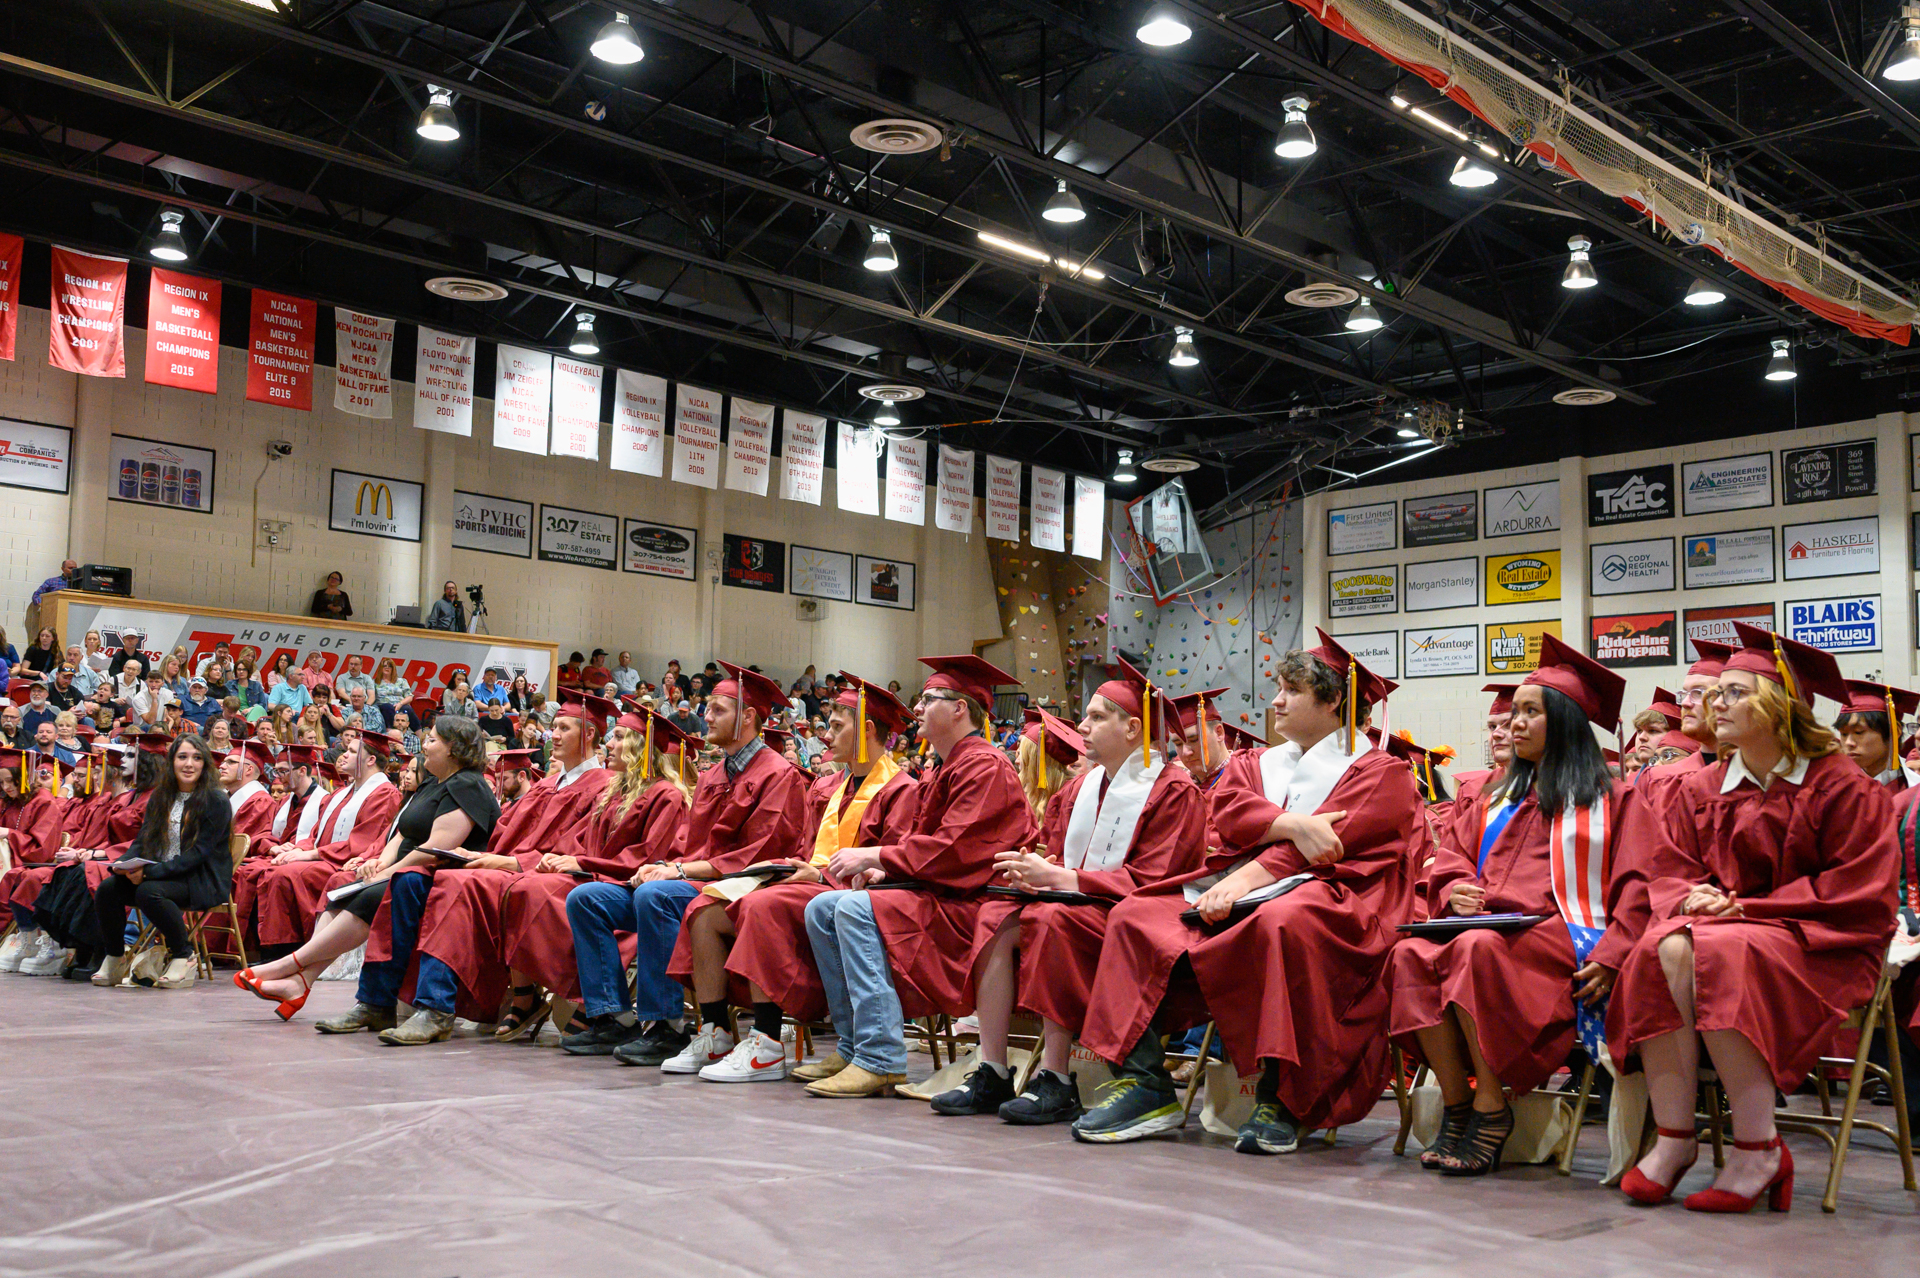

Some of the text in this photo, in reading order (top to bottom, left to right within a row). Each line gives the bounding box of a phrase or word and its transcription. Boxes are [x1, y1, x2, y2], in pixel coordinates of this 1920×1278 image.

[65, 274, 112, 291] REGION IX
[164, 284, 208, 301] REGION IX
[62, 294, 114, 312] WRESTLING
[270, 300, 298, 314] NJCAA
[172, 305, 200, 319] MEN'S
[58, 314, 114, 332] CHAMPIONS
[264, 312, 303, 329] NATIONAL
[352, 313, 378, 327] COACH
[156, 321, 213, 341] BASKETBALL
[270, 329, 296, 342] MEN'S
[336, 321, 392, 341] KEN ROCHLITZ
[72, 336, 98, 349] 2001
[351, 339, 377, 352] NJCAA
[436, 337, 461, 349] COACH
[156, 341, 210, 360] CHAMPIONS
[255, 340, 308, 359] BASKETBALL
[422, 348, 446, 360] FLOYD
[254, 354, 309, 373] TOURNAMENT
[352, 354, 376, 365] MEN'S
[171, 364, 194, 376] 2015
[339, 363, 387, 381] BASKETBALL
[429, 364, 464, 377] NATIONAL
[503, 371, 516, 380] JIM
[557, 362, 600, 377] VOLLEYBALL
[266, 372, 296, 385] ELITE 8
[337, 376, 390, 394] HALL OF FAME
[426, 377, 467, 391] WRESTLING
[269, 387, 291, 399] 2015
[512, 386, 534, 398] NJCAA
[589, 384, 596, 394] IX
[350, 395, 373, 407] 2001
[420, 390, 470, 406] HALL OF FAME
[625, 392, 648, 404] REGION
[688, 397, 709, 409] NJCAA
[436, 407, 454, 417] 2001
[503, 398, 542, 413] WRESTLING
[498, 411, 546, 427] HALL OF FAME
[621, 407, 660, 422] VOLLEYBALL
[683, 410, 713, 423] NATIONAL
[557, 415, 598, 430] CHAMPIONS
[739, 416, 760, 427] REGION
[796, 423, 814, 433] NJCAA
[513, 427, 530, 438] 2009
[621, 423, 659, 438] CHAMPIONS
[679, 422, 717, 438] VOLLEYBALL
[744, 428, 763, 440] NORTH
[677, 435, 718, 451] TOURNAMENT
[792, 434, 818, 445] NATIONAL
[19, 447, 56, 457] COMPANIES
[632, 442, 648, 452] 2009
[734, 439, 768, 454] VOLLEYBALL
[788, 444, 821, 458] VOLLEYBALL
[898, 444, 916, 454] NJCAA
[689, 451, 704, 461] 11TH
[734, 451, 767, 466] CHAMPIONS
[1848, 450, 1862, 458] 369
[786, 456, 822, 470] TOURNAMENT
[895, 456, 920, 467] NATIONAL
[944, 458, 962, 466] REGION
[1794, 461, 1831, 473] LAVENDER
[688, 464, 704, 475] 2009
[743, 466, 758, 475] 2013
[802, 471, 819, 481] PLACE
[891, 467, 922, 480] VOLLEYBALL
[996, 467, 1012, 475] NJCAA
[1712, 466, 1767, 478] ENGINEERING
[993, 478, 1015, 487] NATIONAL
[1717, 474, 1767, 485] ASSOCIATES
[1802, 472, 1820, 483] ROSE
[797, 482, 811, 491] 2013
[890, 479, 924, 491] TOURNAMENT
[942, 483, 970, 496] VOLLEYBALL
[1845, 483, 1868, 492] Powell
[904, 493, 920, 504] PLACE
[990, 489, 1019, 499] VOLLEYBALL
[1596, 474, 1666, 514] TREC
[899, 505, 913, 513] 2014
[942, 498, 970, 509] CHAMPIONS
[989, 499, 1020, 510] TOURNAMENT
[1035, 504, 1061, 515] VOLLEYBALL
[480, 508, 526, 528] PVHC
[1365, 509, 1392, 519] United
[351, 518, 397, 533] i'm lovin' it
[455, 519, 526, 539] SPORTS MEDICINE
[546, 516, 579, 533] 307
[581, 521, 602, 532] REAL
[1035, 517, 1060, 528] CHAMPIONS
[1493, 516, 1552, 533] ARDURRA
[581, 531, 611, 543] ESTATE
[1812, 533, 1874, 547] HASKELL
[1628, 554, 1650, 562] CODY
[1812, 547, 1874, 558] Furniture Flooring
[548, 553, 608, 566] www.WeAre307.com
[1506, 560, 1541, 572] WYOMING
[1628, 560, 1669, 570] REGIONAL
[1501, 567, 1548, 583] Real Estate
[1628, 569, 1659, 577] HEALTH
[1332, 574, 1394, 591] WOODWARD
[1408, 575, 1475, 592] MorganStanley
[1793, 599, 1874, 625] BLAIR'S
[1687, 622, 1730, 638] VISION
[1796, 627, 1871, 644] thriftway
[240, 629, 400, 654] HOME OF THE
[1411, 635, 1473, 654] Advantage
[1598, 634, 1669, 648] Ridgeline
[1372, 647, 1389, 656] Bank
[1597, 646, 1671, 659] AUTO REPAIR
